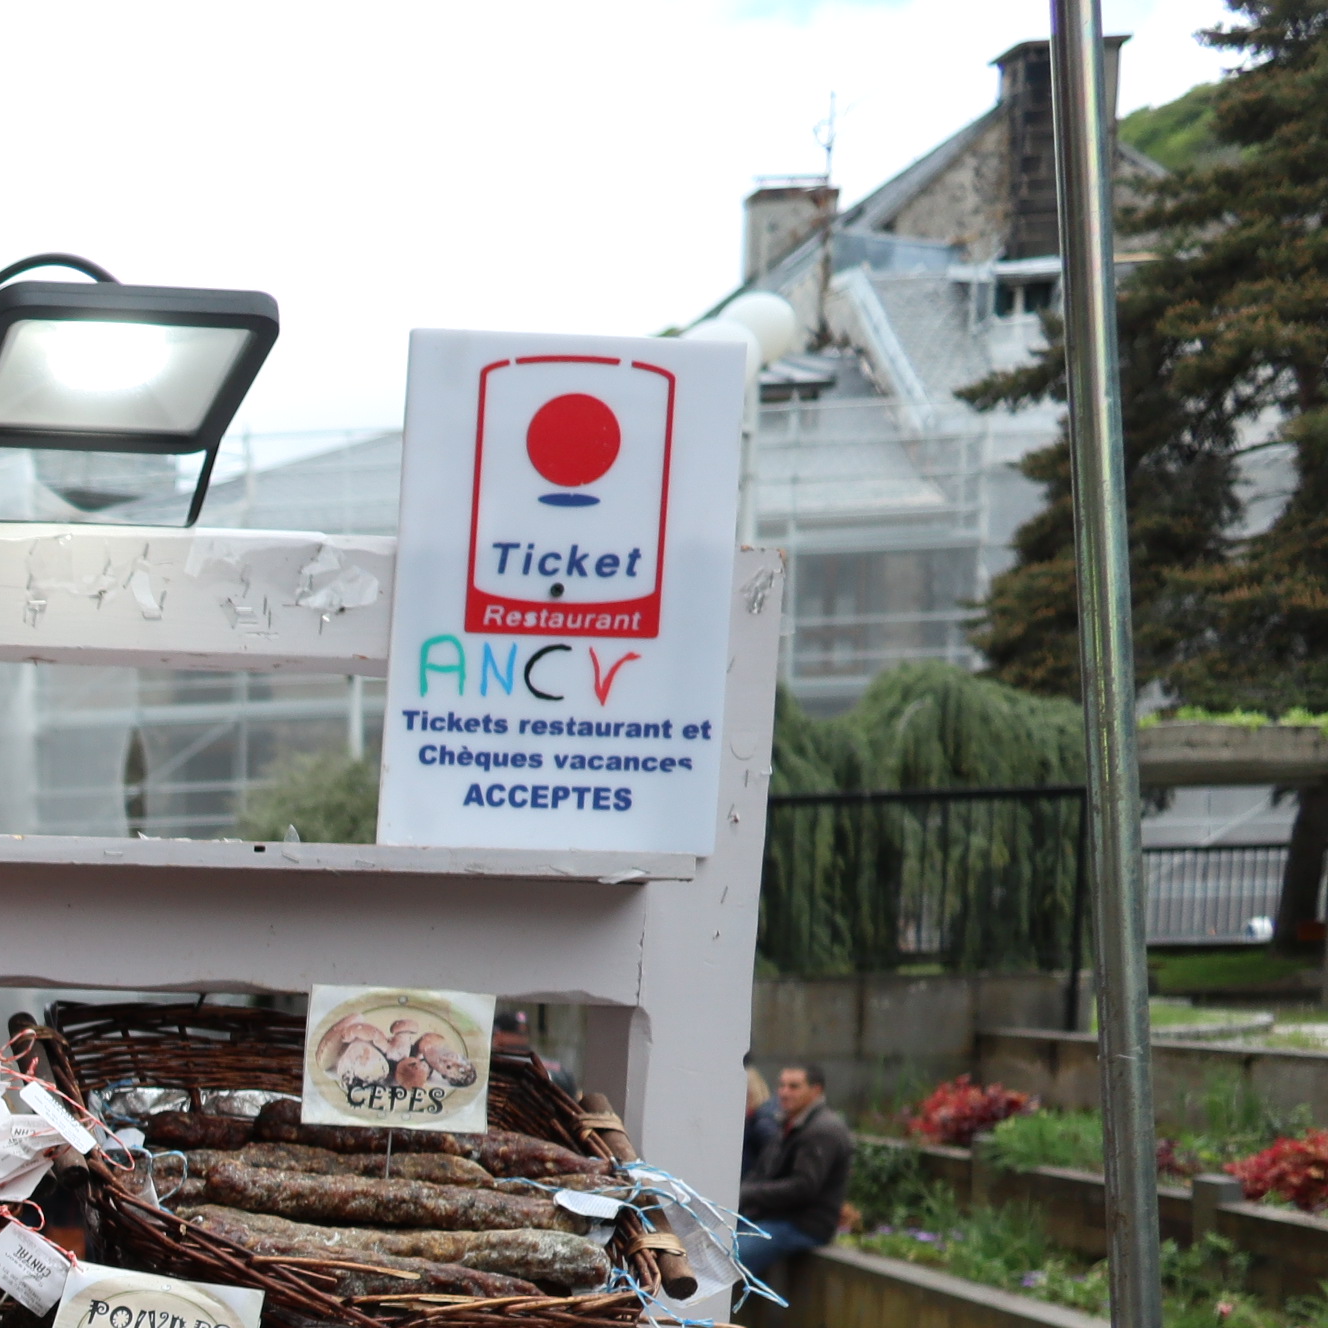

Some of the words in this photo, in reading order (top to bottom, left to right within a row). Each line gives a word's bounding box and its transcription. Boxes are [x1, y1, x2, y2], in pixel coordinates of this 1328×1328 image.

[491, 542, 643, 578] Ticket
[482, 604, 643, 632] Restaurant
[419, 633, 643, 707] ANCV
[401, 710, 509, 734] Tickets
[518, 716, 673, 740] restaurant
[681, 719, 713, 740] et
[417, 745, 544, 772] Chèques
[553, 751, 694, 773] vacances
[462, 783, 634, 813] ACCEPTES
[344, 1077, 448, 1117] CEPES
